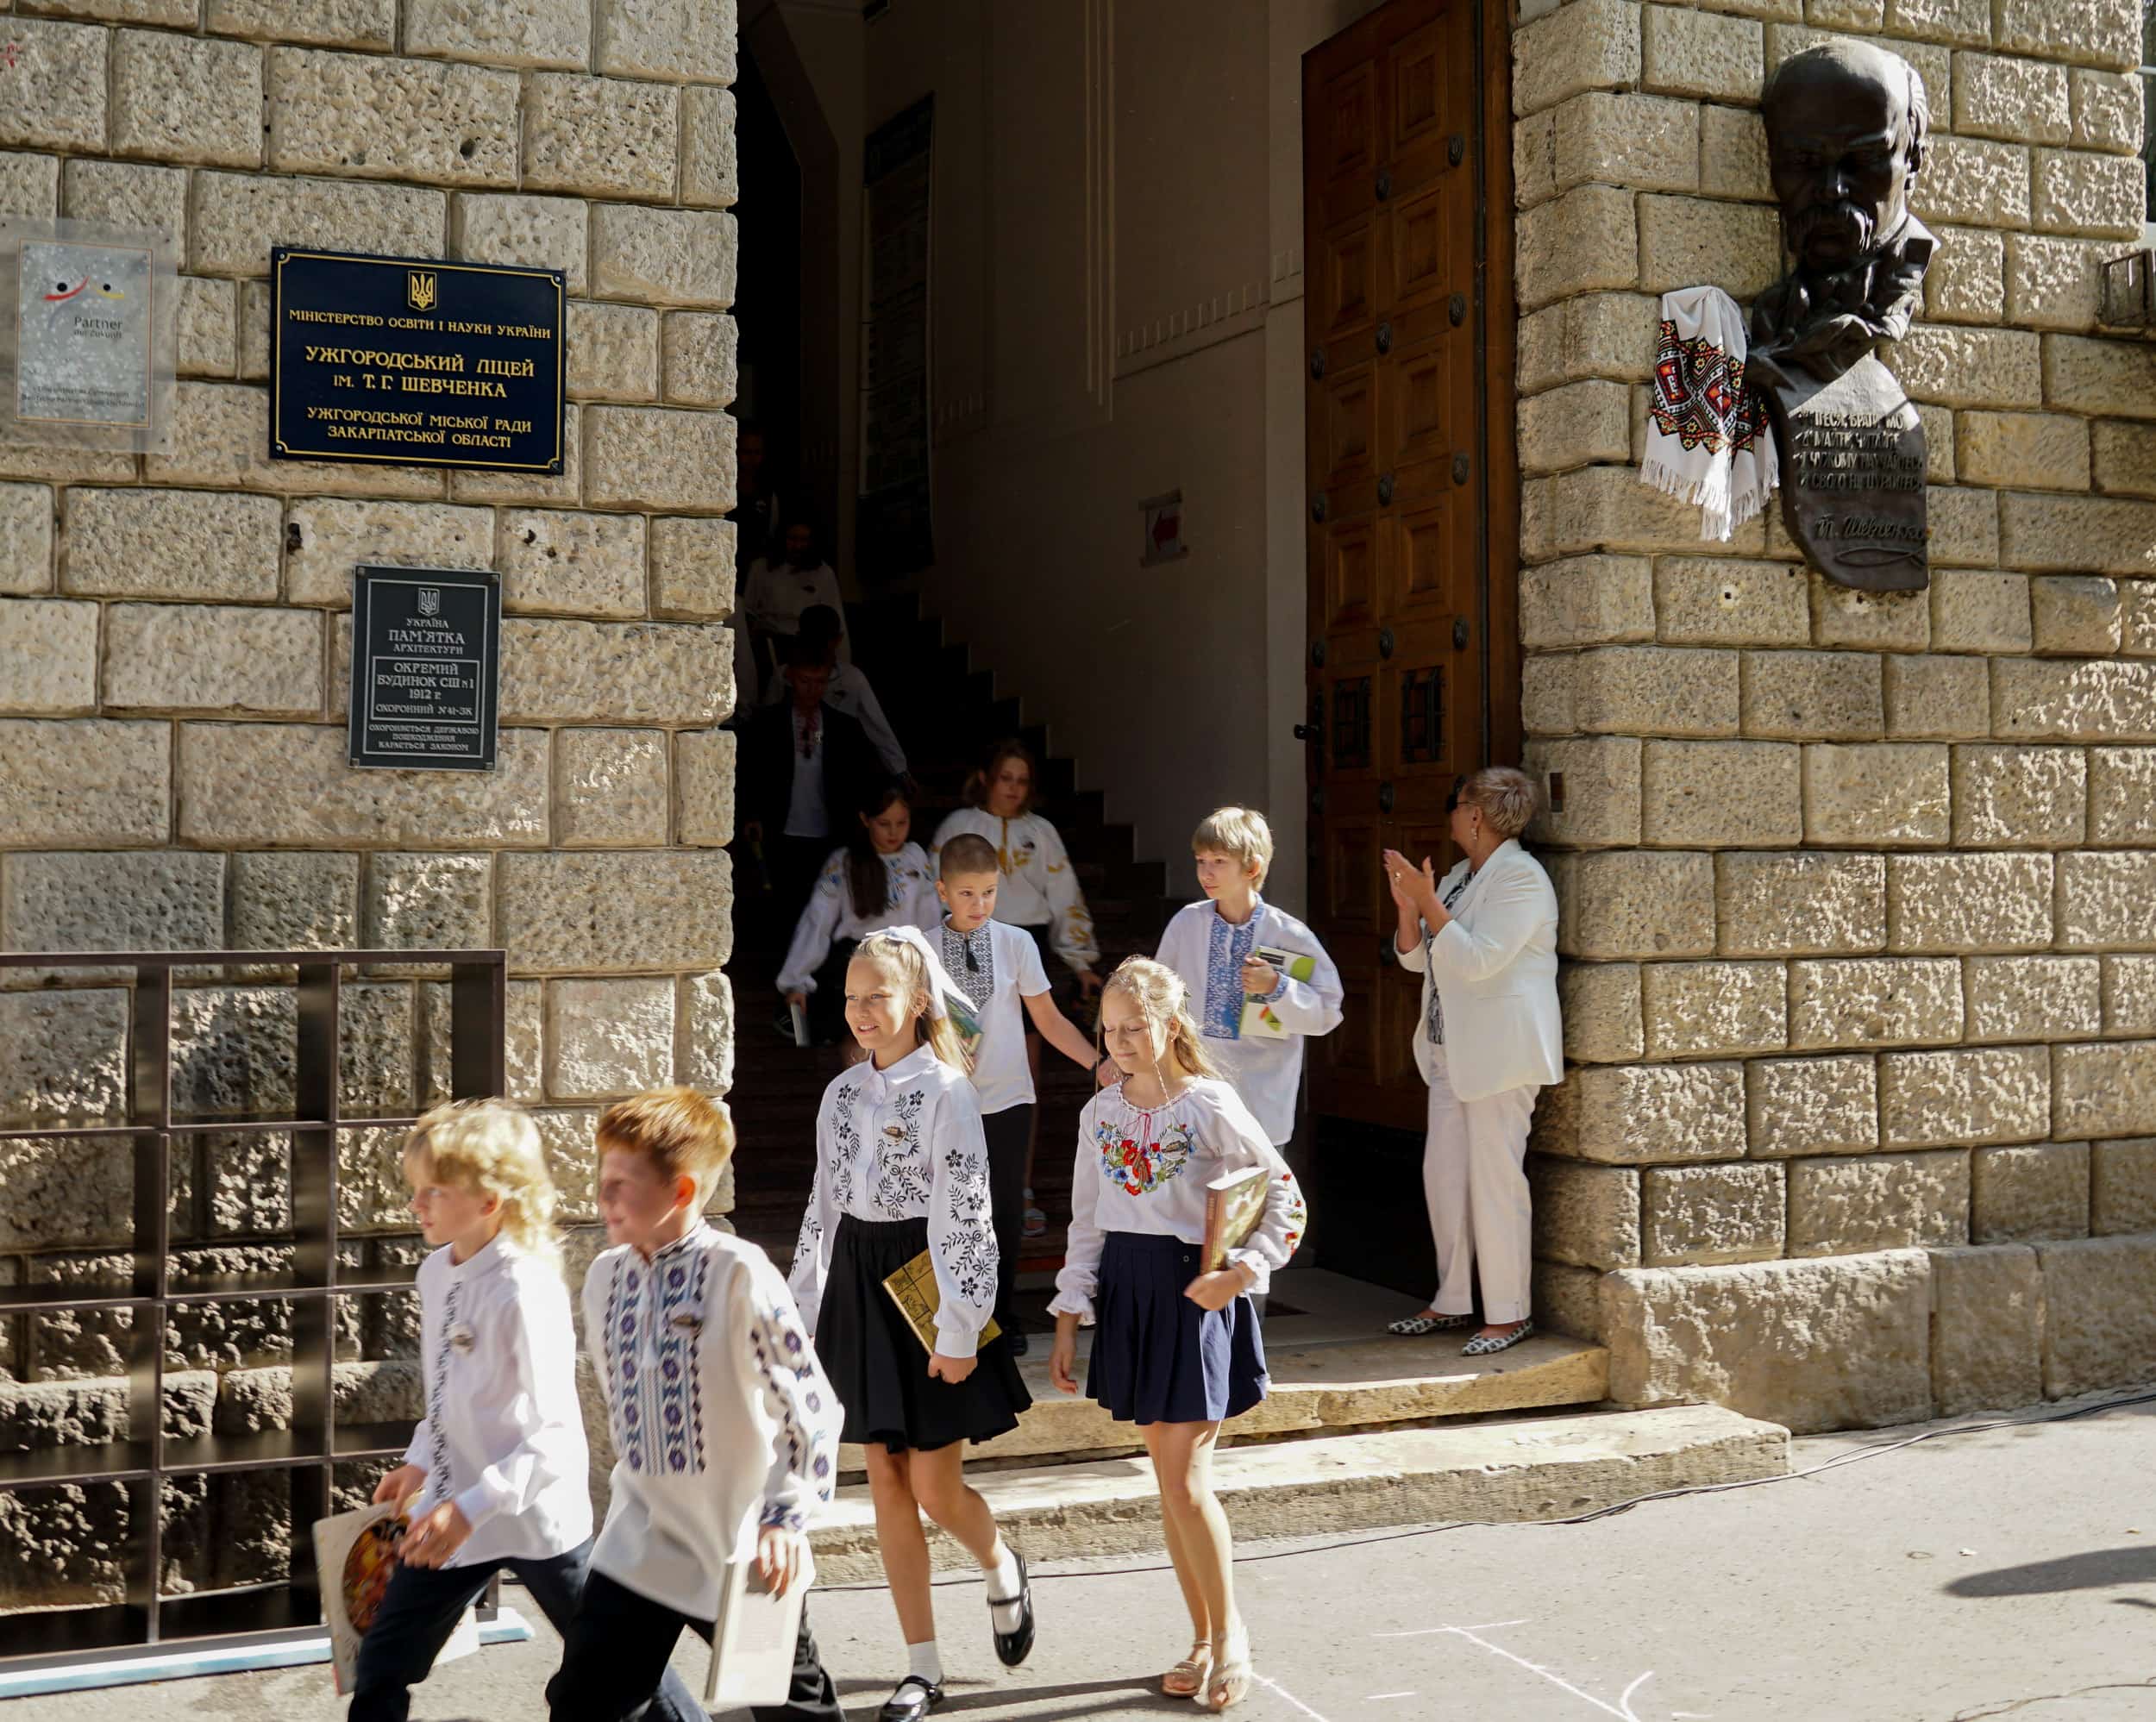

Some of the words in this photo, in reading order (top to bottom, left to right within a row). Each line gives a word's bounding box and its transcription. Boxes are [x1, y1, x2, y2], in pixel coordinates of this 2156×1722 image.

[74, 316, 122, 329] Partner
[289, 309, 384, 326] МІНІСТЕРСТВО
[388, 316, 435, 331] ОСВІТИ
[438, 321, 444, 332] І
[448, 322, 492, 335] НАУКИ
[497, 323, 551, 339] УКРАЇНИ
[305, 345, 464, 373] УЖГОРОДСЬКИЙ
[476, 358, 535, 378] ЛІЦЕЙ
[333, 374, 354, 388] ІМ.
[401, 376, 507, 398] ШЕВЧЕНКА
[307, 406, 423, 426] УЖГОРОДСЬКОЇ
[429, 413, 488, 429] МІСЬКОЇ
[494, 419, 532, 433] РАДИ
[328, 425, 445, 444] ЗАКАРПАТСЬКОЇ
[452, 433, 511, 448] ОБЛАСТІ
[406, 617, 449, 629] УКРАЇНА
[388, 629, 466, 645] ПАМ'ЯТКА
[392, 644, 463, 655] АРХІТЕКТУРИ
[393, 662, 459, 675] ОКРЕМИЙ
[377, 674, 437, 688] БУДИНОК
[409, 689, 432, 699] 1912
[375, 704, 434, 715] ОХОРОННИЙ
